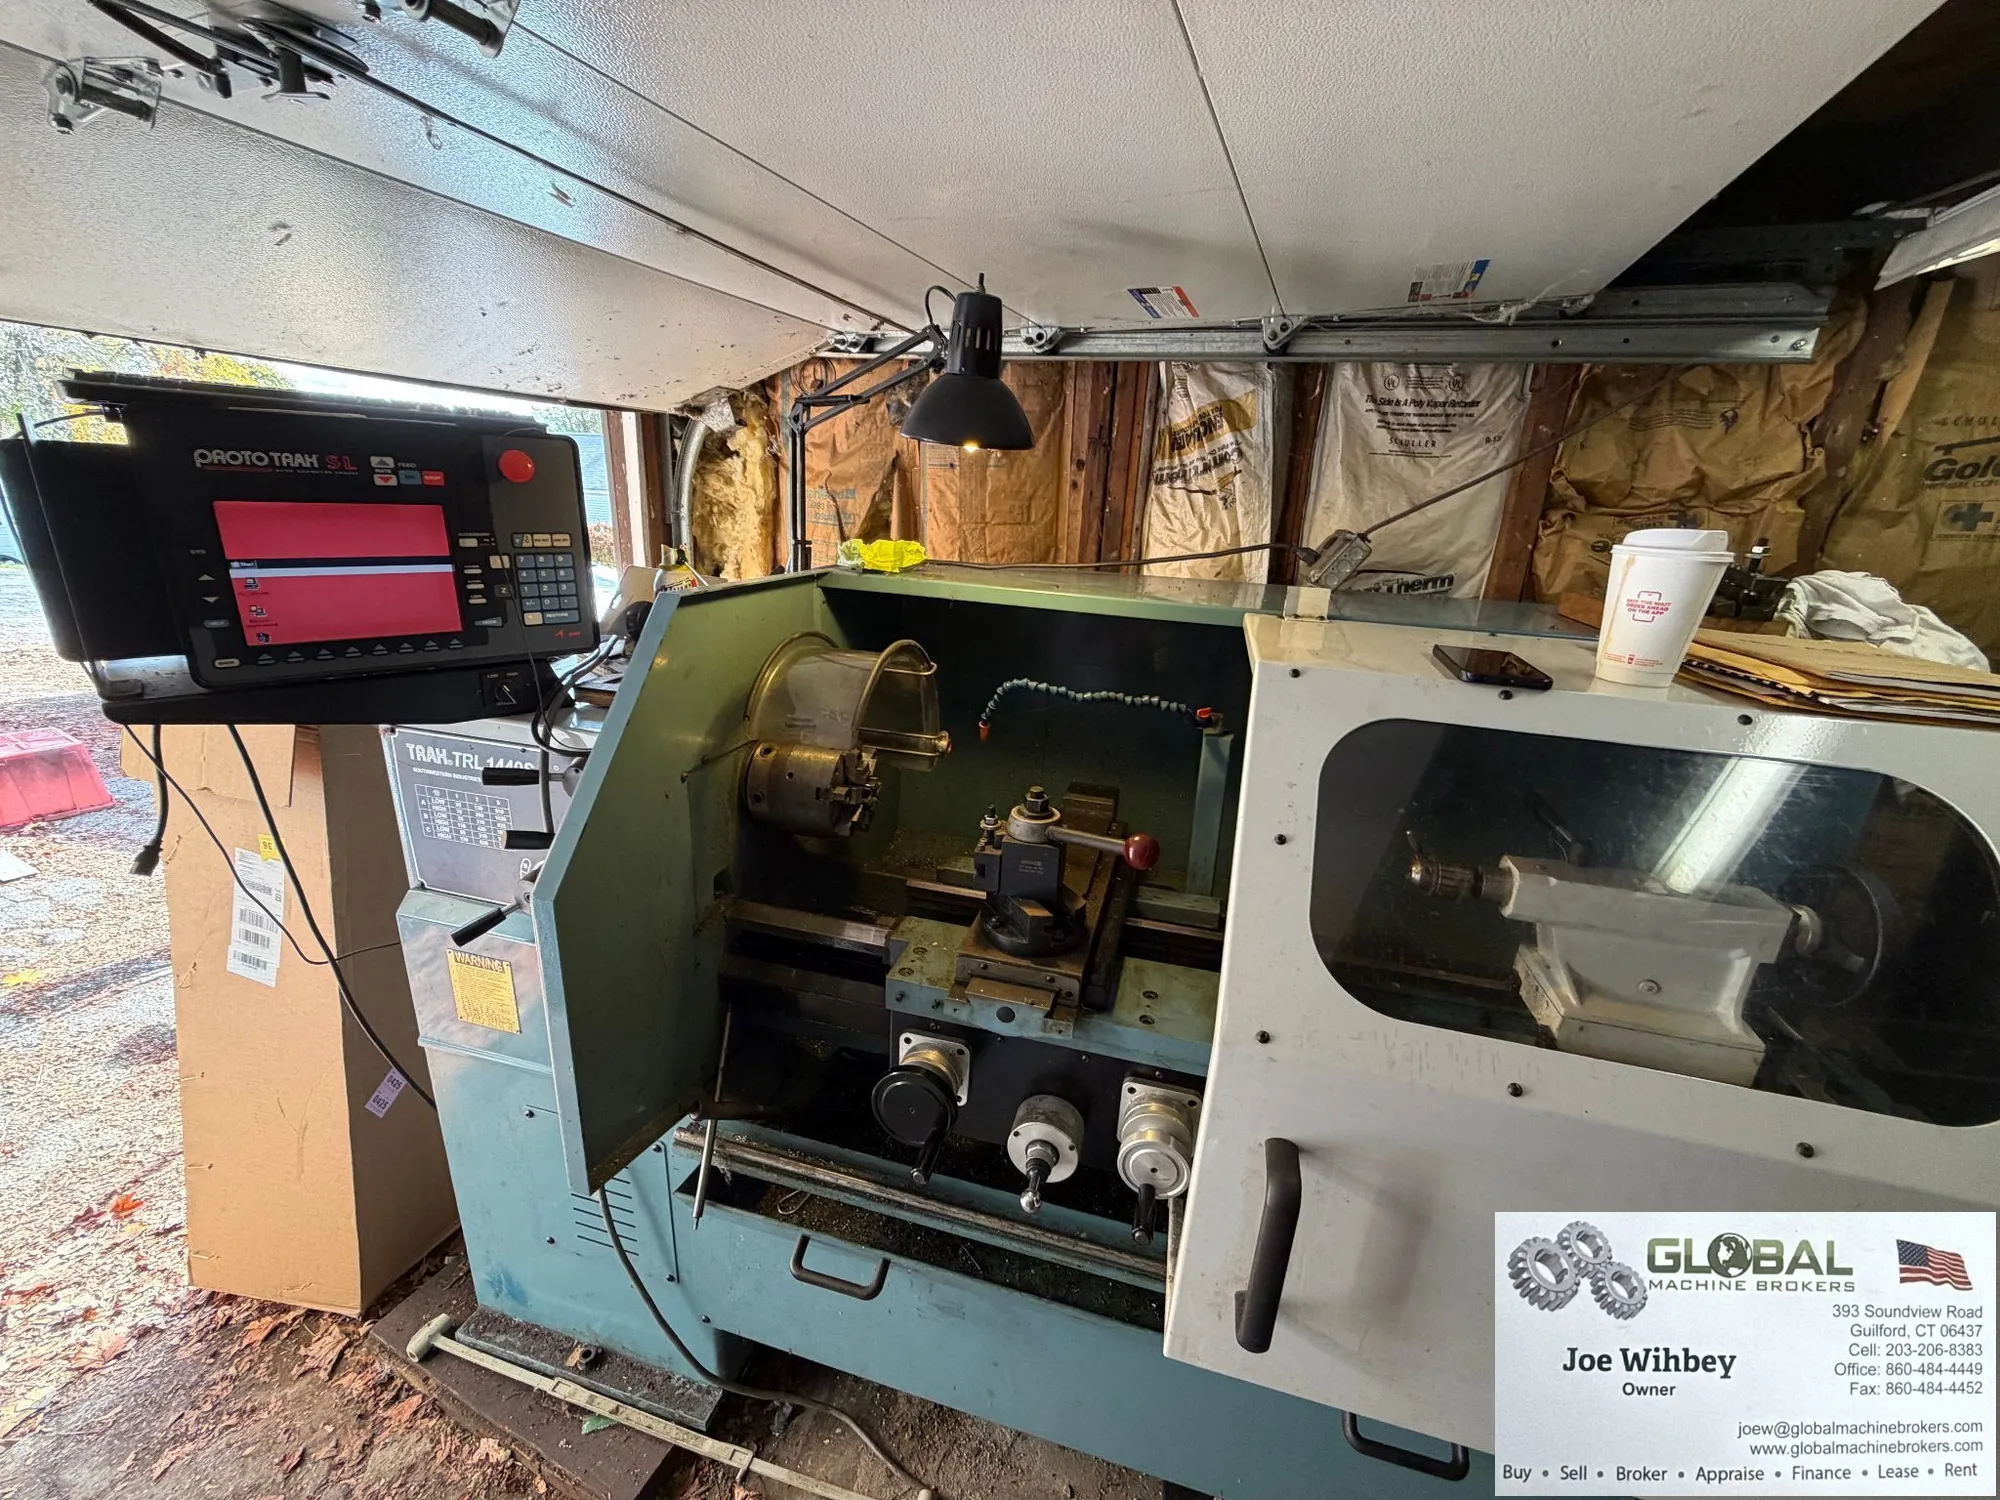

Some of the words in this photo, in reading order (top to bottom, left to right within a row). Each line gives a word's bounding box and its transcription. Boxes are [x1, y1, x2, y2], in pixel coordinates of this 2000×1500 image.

[452, 751, 484, 770] TRL
[454, 951, 503, 972] WARNING
[387, 1075, 402, 1090] 0425
[373, 1094, 389, 1110] 0425
